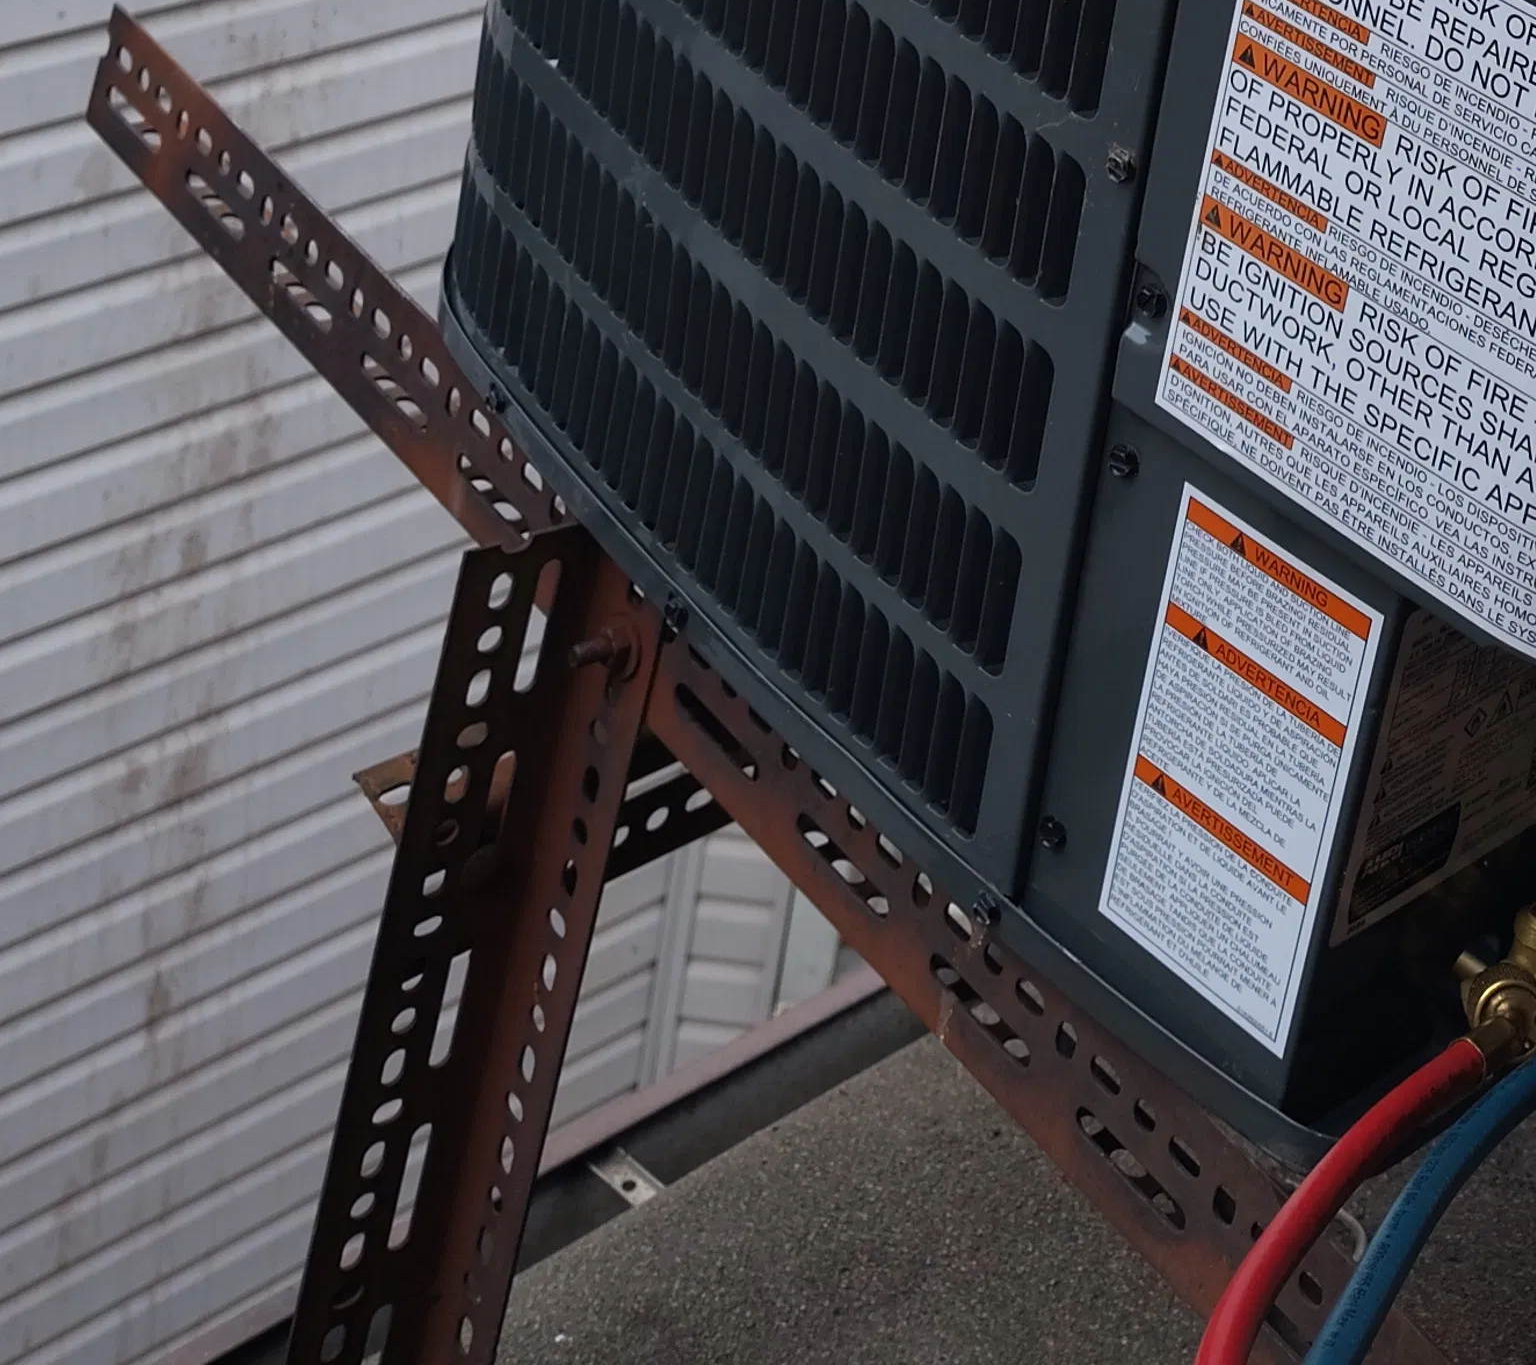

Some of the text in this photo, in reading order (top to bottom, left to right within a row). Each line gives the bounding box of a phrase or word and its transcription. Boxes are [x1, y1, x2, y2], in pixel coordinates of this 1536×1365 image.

[1224, 62, 1264, 99] OF
[1268, 90, 1403, 185] PROPERLY
[1407, 173, 1434, 207] IN
[1264, 52, 1381, 141] WARNING
[1394, 133, 1457, 188] RISK
[1462, 175, 1501, 207] OF
[1380, 42, 1431, 80] RIESGO
[1433, 72, 1453, 93] DE
[1455, 84, 1521, 130] INCENDIO
[1424, 34, 1464, 73] DO
[1470, 59, 1530, 108] NOT
[1213, 118, 1364, 233] FLAMMABLE
[1218, 90, 1333, 181] FEDERAL
[1344, 170, 1382, 210] OR
[1387, 194, 1470, 263] LOCAL
[1195, 256, 1336, 371] DUCTWORK,
[1346, 357, 1434, 427] OTHER
[1441, 413, 1511, 477] THAN
[1197, 230, 1233, 267] BE
[1238, 254, 1344, 340] IGNITION
[1348, 327, 1473, 421] SOURCES
[1230, 214, 1343, 305] WARNING
[1358, 301, 1419, 357] RISK
[1425, 344, 1462, 376] OF
[1466, 368, 1529, 423] FIRE
[1190, 285, 1237, 334] USE
[1243, 320, 1304, 379] WITH
[1311, 364, 1358, 415] THE
[1363, 403, 1481, 492] SPECIFIC
[1185, 521, 1352, 641] CHECK BOTH LIQUID AND SUCTION LINE
[1255, 547, 1328, 608] WARNING
[1214, 643, 1320, 728] ADVERTENCIA
[1171, 787, 1295, 887] AVERTISSEMENT
